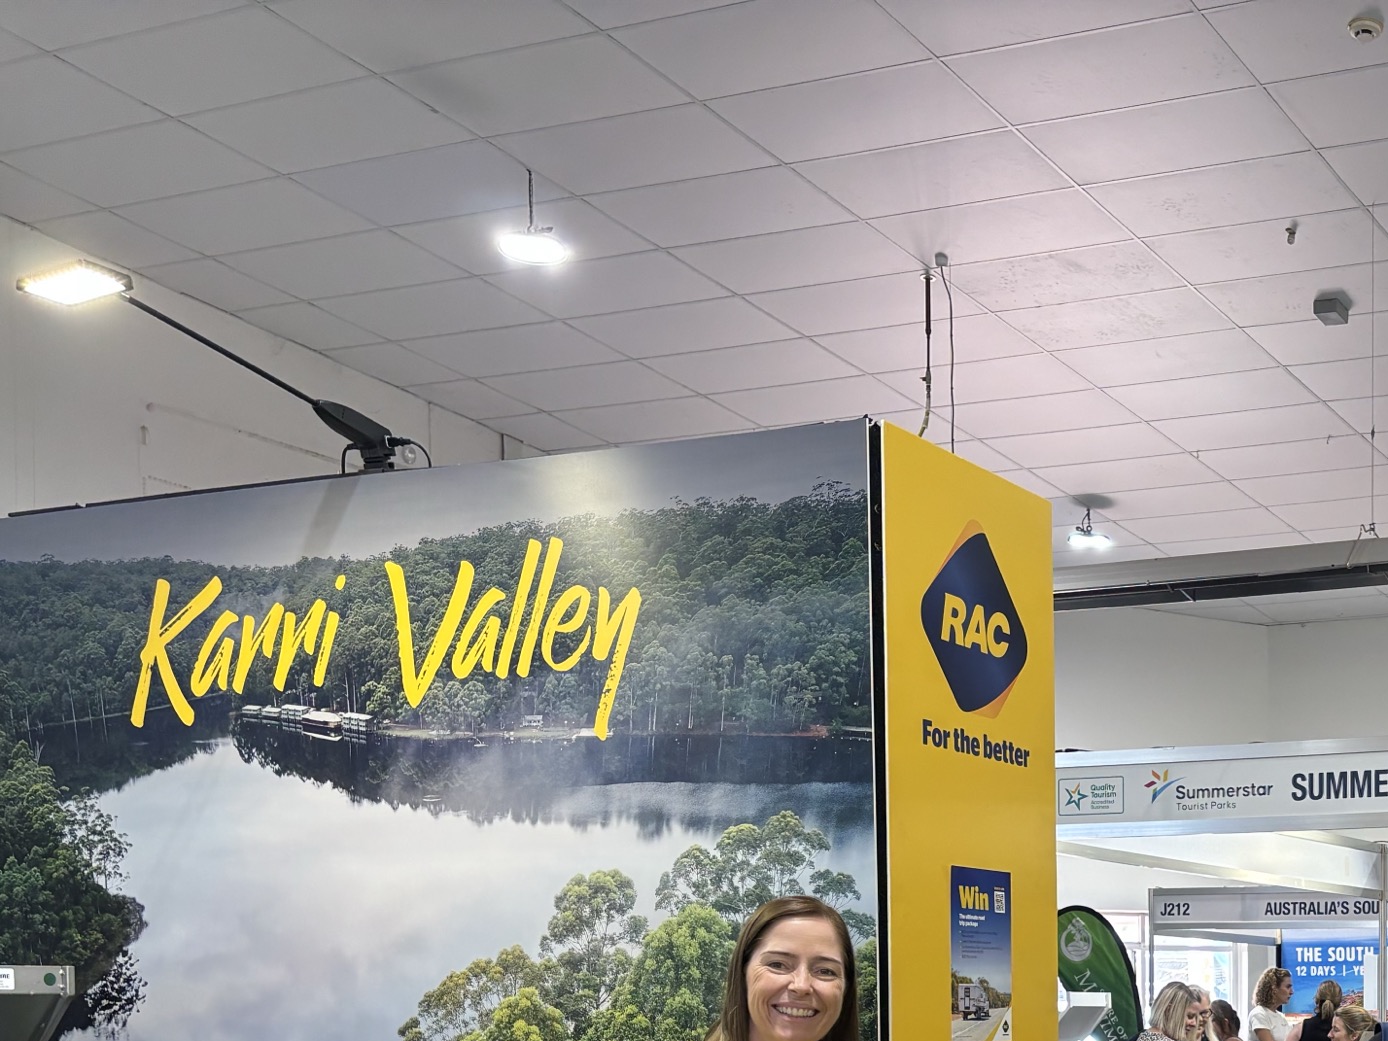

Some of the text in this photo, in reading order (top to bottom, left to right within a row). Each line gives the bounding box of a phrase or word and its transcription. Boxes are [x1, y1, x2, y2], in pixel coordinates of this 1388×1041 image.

[941, 592, 1011, 658] RAC
[131, 537, 642, 741] Karri Valley
[922, 718, 1030, 767] For the better
[1090, 783, 1116, 793] Quality
[1090, 790, 1117, 799] Tourism
[1175, 782, 1274, 800] Summerstar
[1176, 800, 1237, 812] Tourist Parks
[958, 885, 990, 911] Win
[1160, 903, 1191, 917] J212
[1264, 900, 1350, 917] AUSTRALIA'S
[1296, 947, 1322, 963] THE
[1296, 966, 1307, 977] 12
[1310, 965, 1336, 976] DAYS
